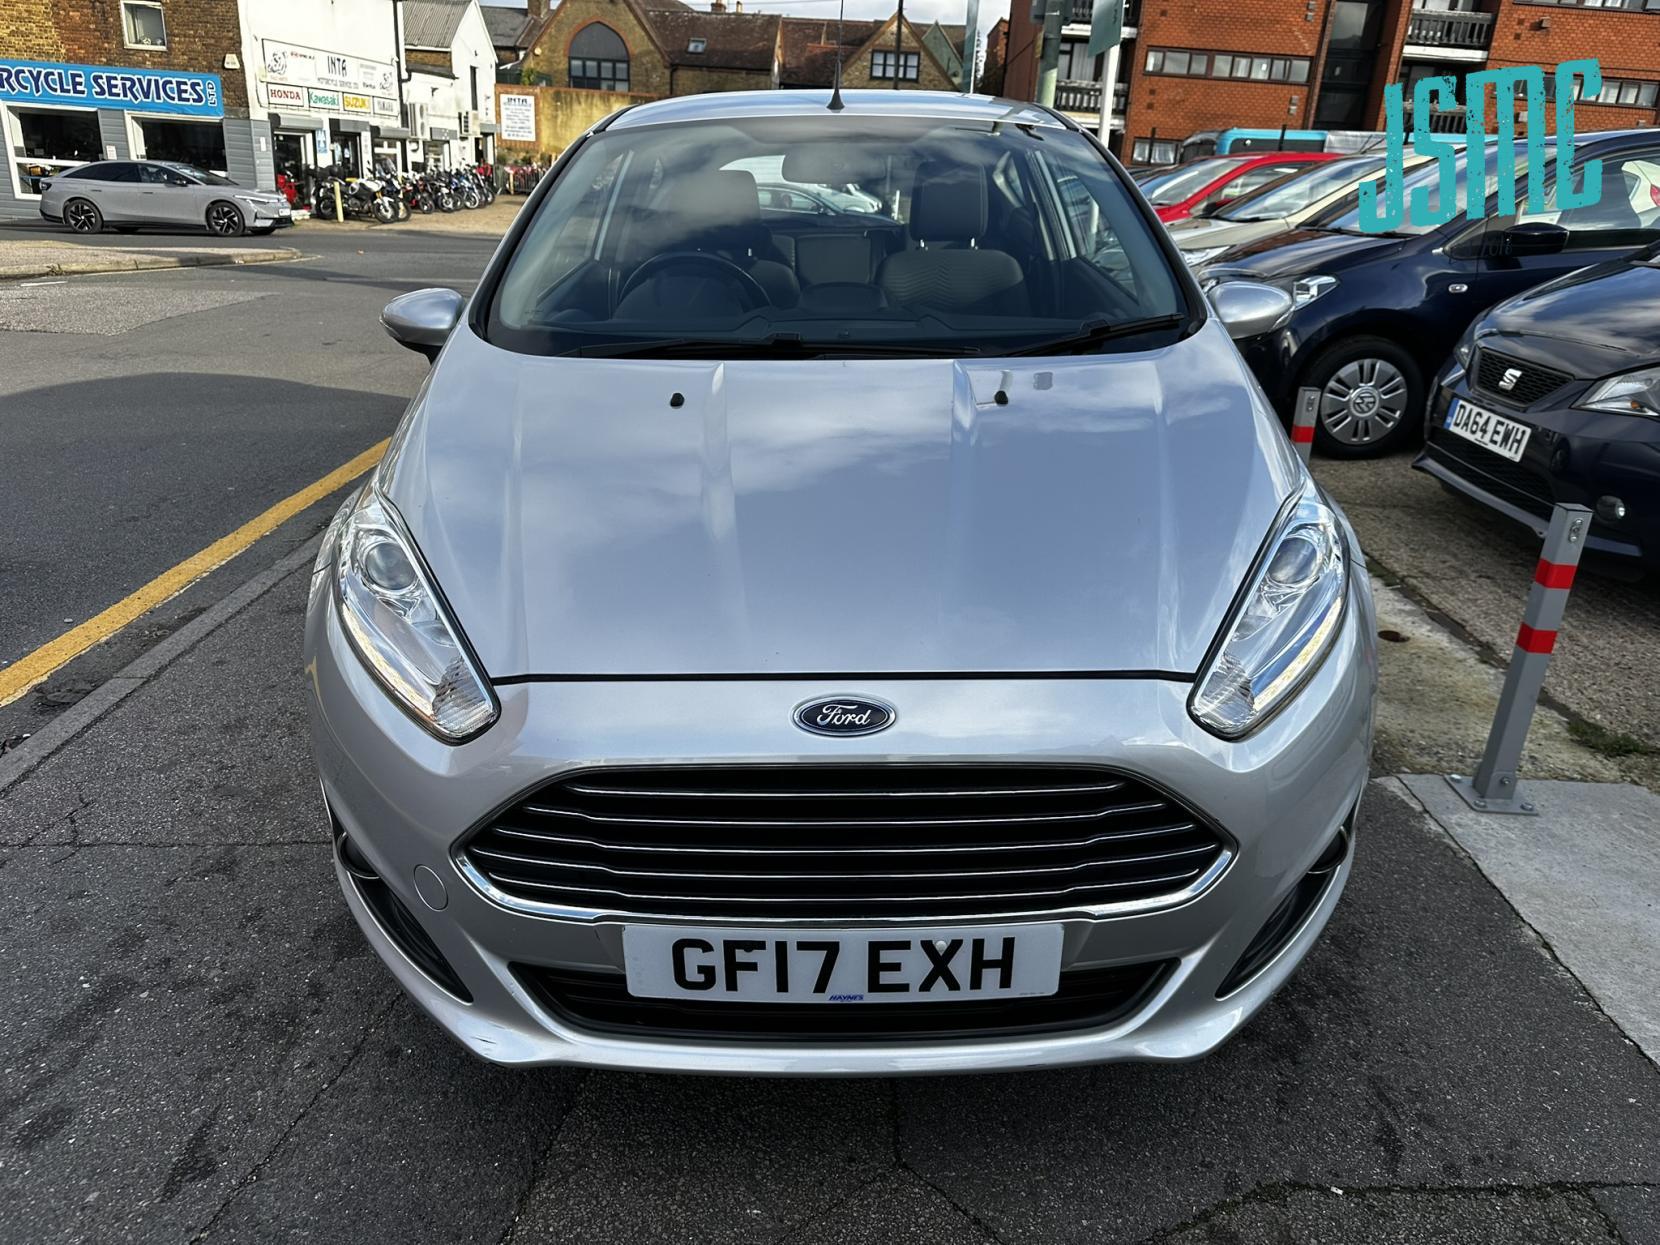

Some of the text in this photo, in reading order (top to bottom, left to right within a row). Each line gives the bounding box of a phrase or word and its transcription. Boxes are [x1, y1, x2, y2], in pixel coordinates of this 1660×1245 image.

[327, 55, 347, 78] INTA
[0, 66, 217, 106] RCYCLE SERVICES LTD
[270, 89, 301, 100] HONDA
[1453, 404, 1526, 455] DA64 EWH
[816, 704, 872, 726] Ford
[671, 936, 1016, 994] GF17 EXH
